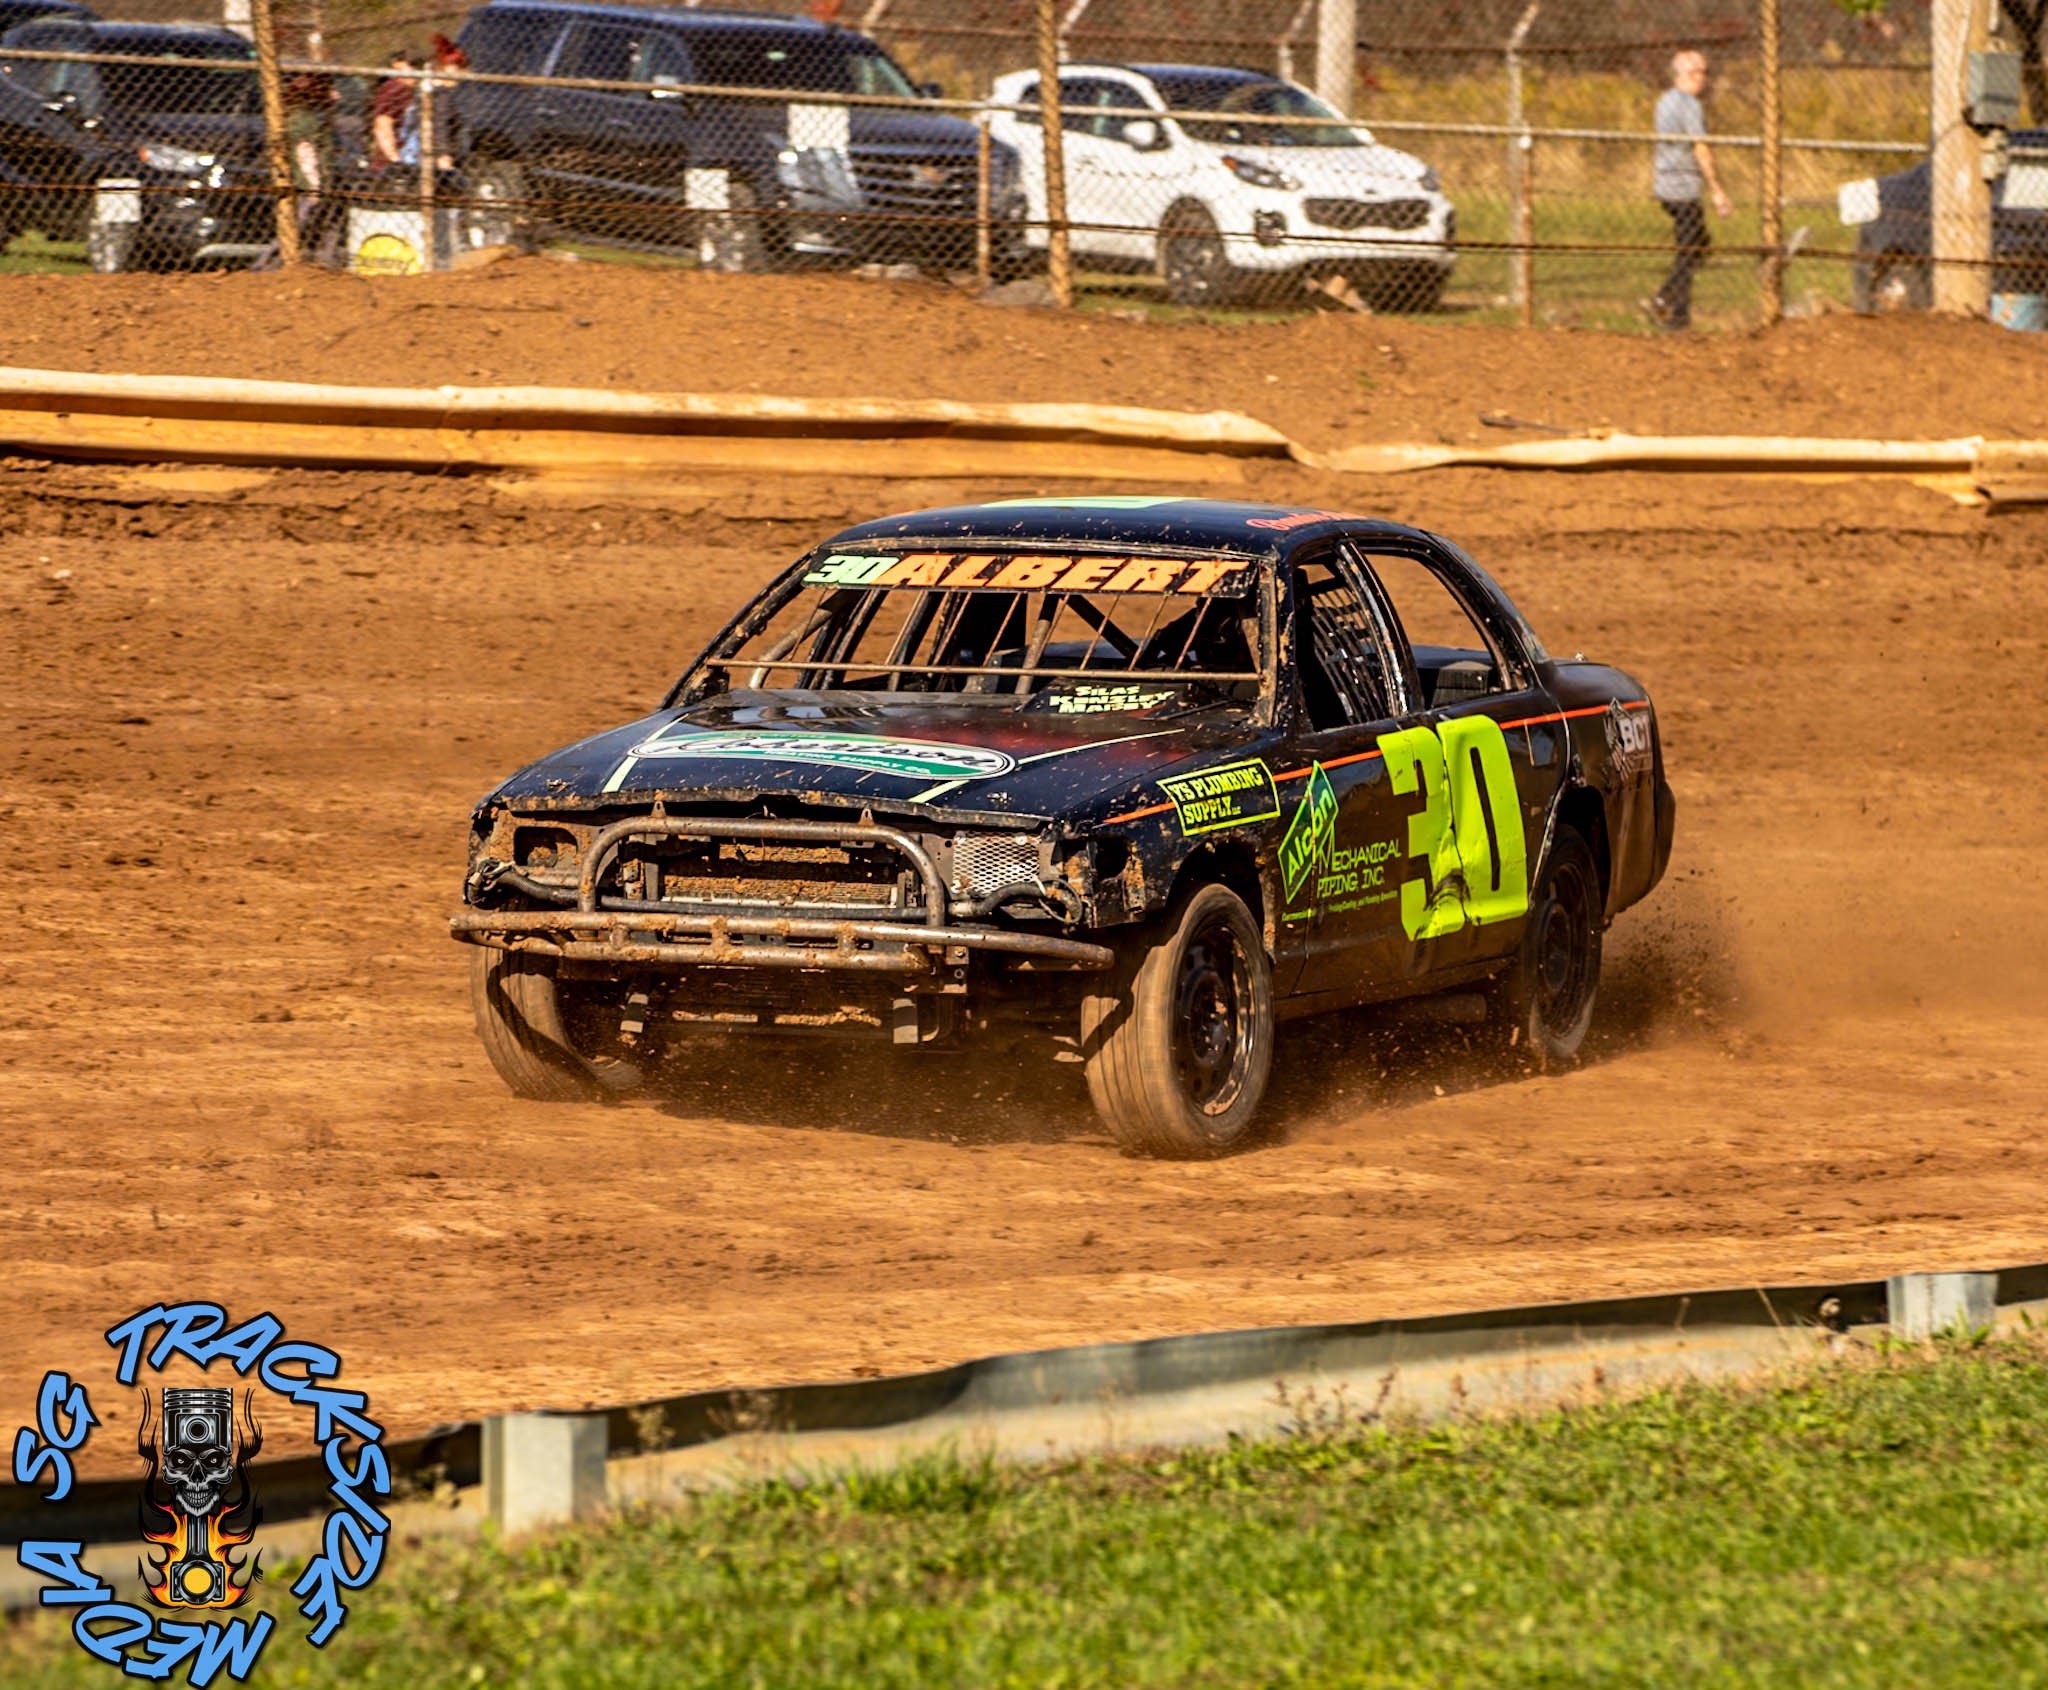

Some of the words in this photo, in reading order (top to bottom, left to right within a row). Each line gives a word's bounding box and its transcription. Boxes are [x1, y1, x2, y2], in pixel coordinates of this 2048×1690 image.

[804, 555, 900, 585] 30
[875, 554, 1249, 593] ALBERT
[838, 755, 903, 770] SUPPLY
[1189, 767, 1264, 798] PLUMBING
[1183, 795, 1232, 824] SUPPLY
[1376, 714, 1529, 941] 30
[1287, 788, 1333, 886] Alcon
[1316, 820, 1402, 876] MECHANICAL
